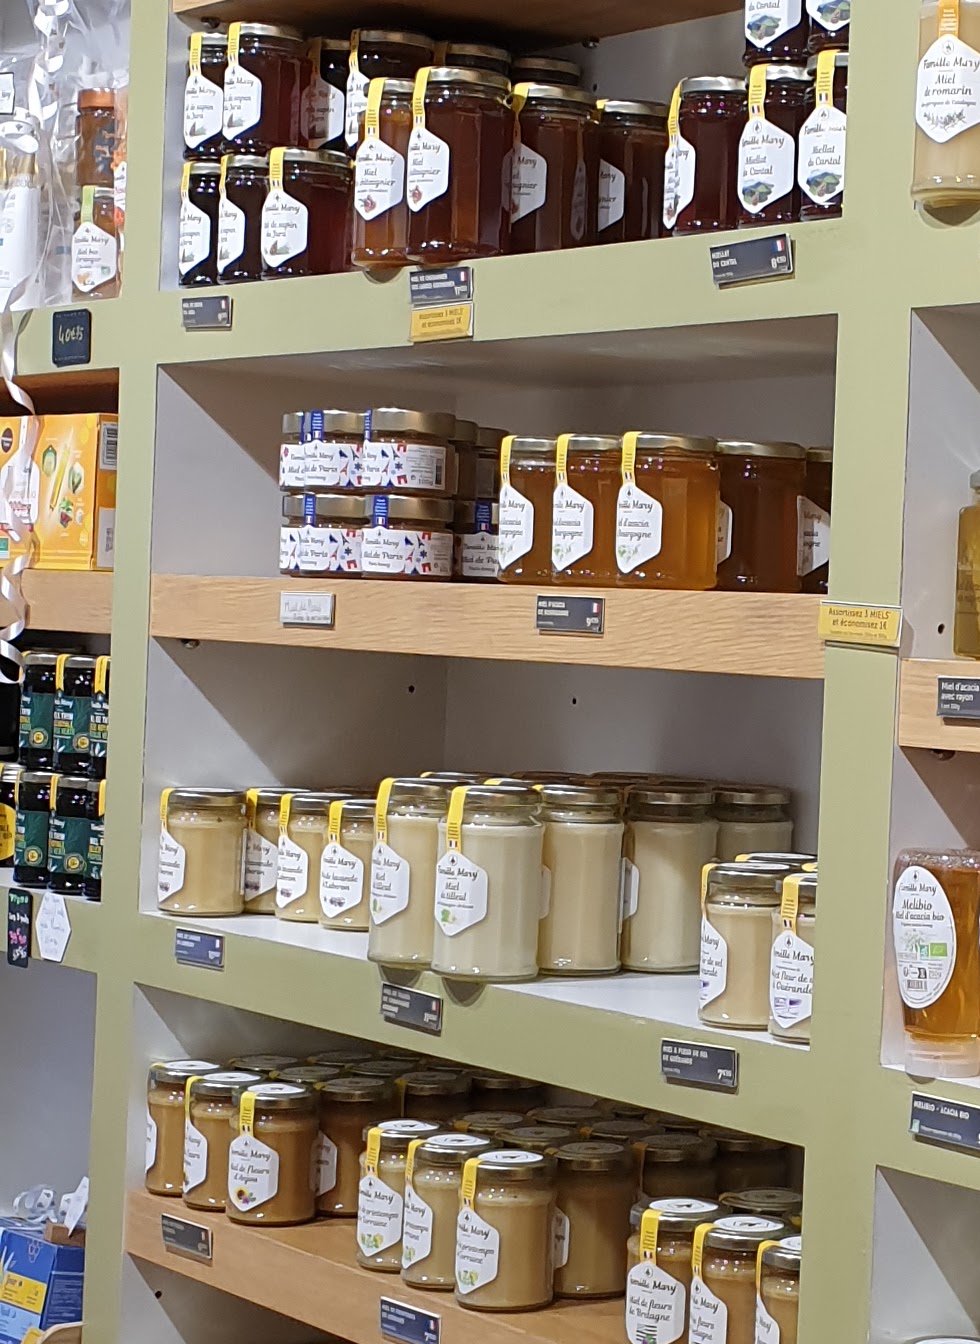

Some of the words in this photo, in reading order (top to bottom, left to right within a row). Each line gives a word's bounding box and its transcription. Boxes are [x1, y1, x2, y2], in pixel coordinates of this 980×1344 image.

[757, 0, 781, 10] Cantal
[935, 73, 956, 85] Miel
[933, 85, 972, 97] romarin
[818, 154, 842, 165] Cantal
[833, 620, 839, 628] et
[457, 869, 478, 881] Mary
[902, 899, 932, 911] Melibio
[469, 1224, 490, 1239] Mary
[652, 1279, 677, 1296] Mary
